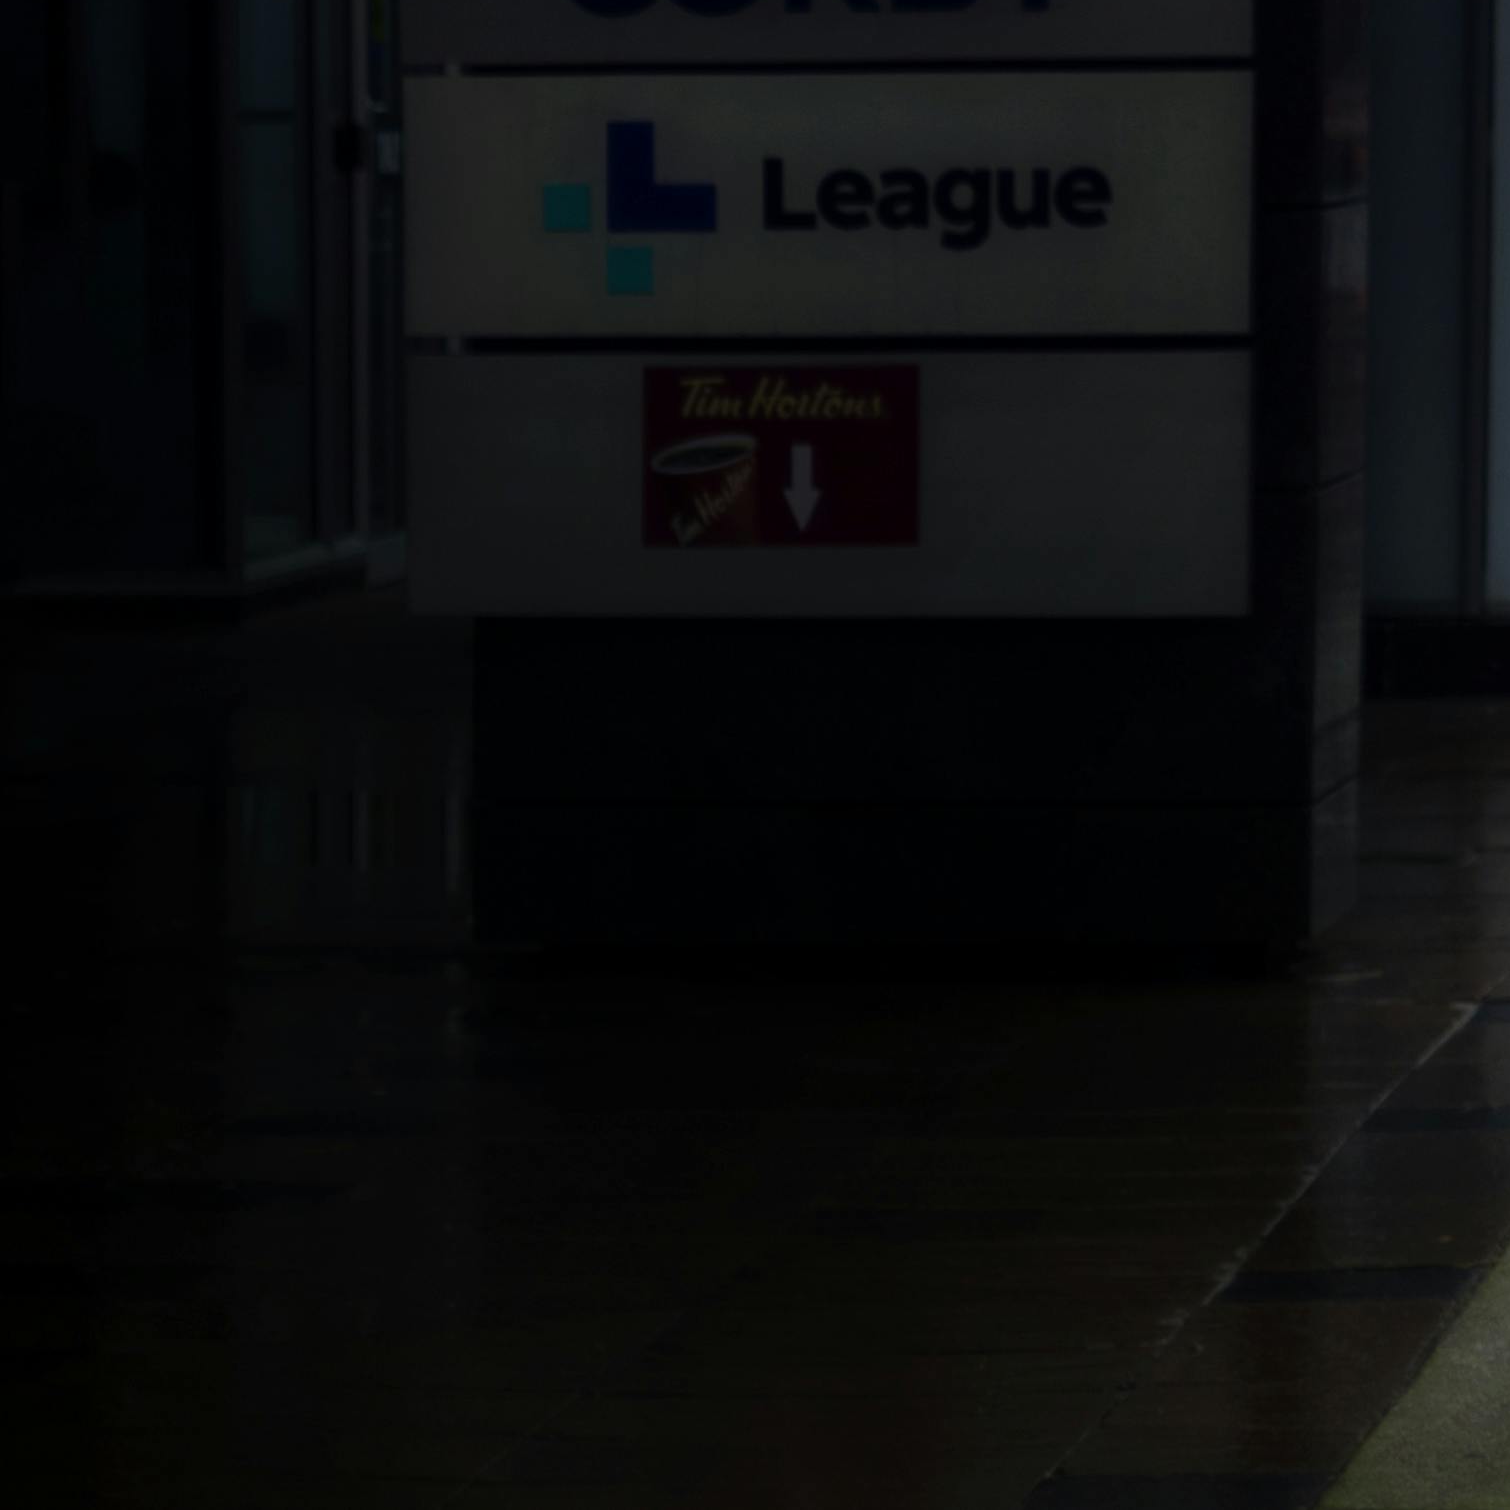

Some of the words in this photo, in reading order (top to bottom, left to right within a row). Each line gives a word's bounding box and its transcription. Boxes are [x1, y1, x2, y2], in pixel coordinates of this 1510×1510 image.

[762, 156, 1112, 250] League
[678, 374, 743, 419] Tim
[747, 371, 888, 420] Hortons
